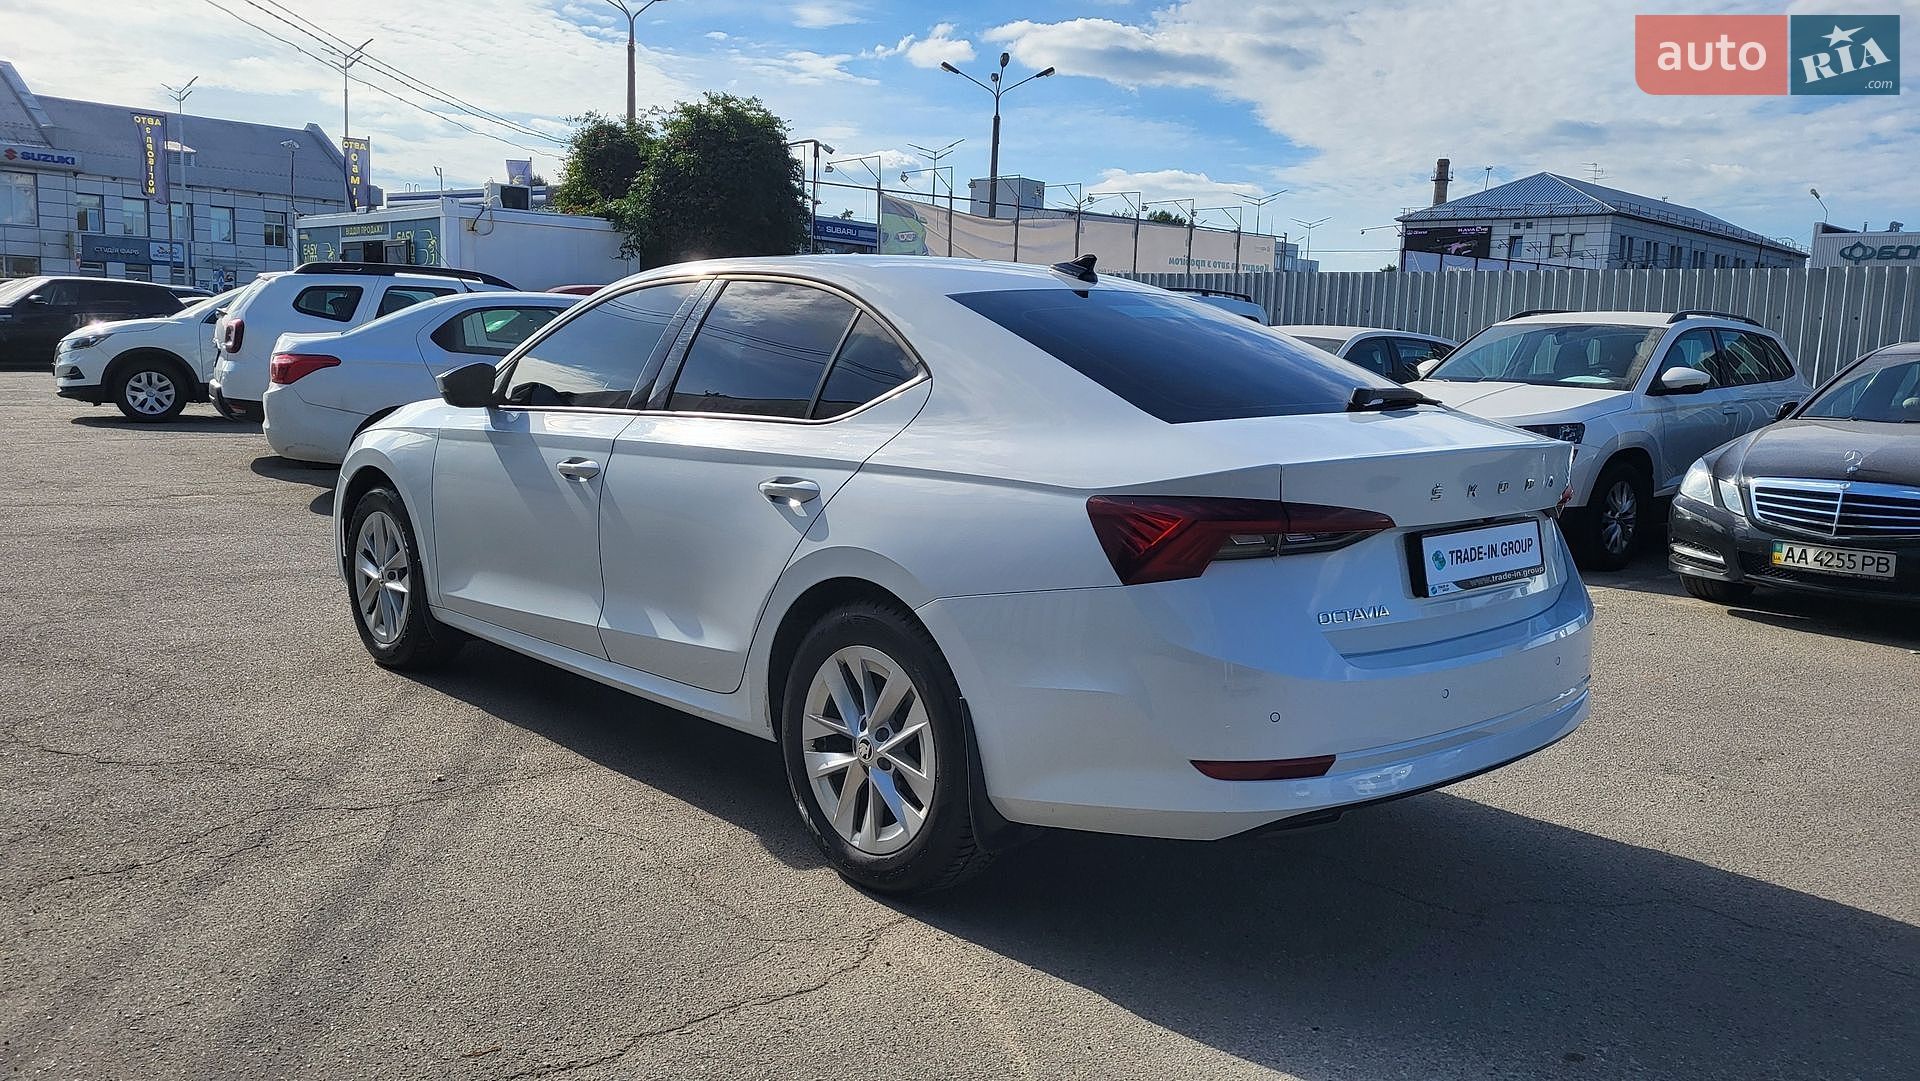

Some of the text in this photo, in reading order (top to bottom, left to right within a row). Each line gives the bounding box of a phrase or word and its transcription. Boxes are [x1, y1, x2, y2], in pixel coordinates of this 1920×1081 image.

[20, 151, 76, 165] SUZUKI
[825, 225, 857, 236] SUBARU
[1783, 546, 1890, 574] AA 4255 PB
[1317, 604, 1391, 625] OCTAVIA
